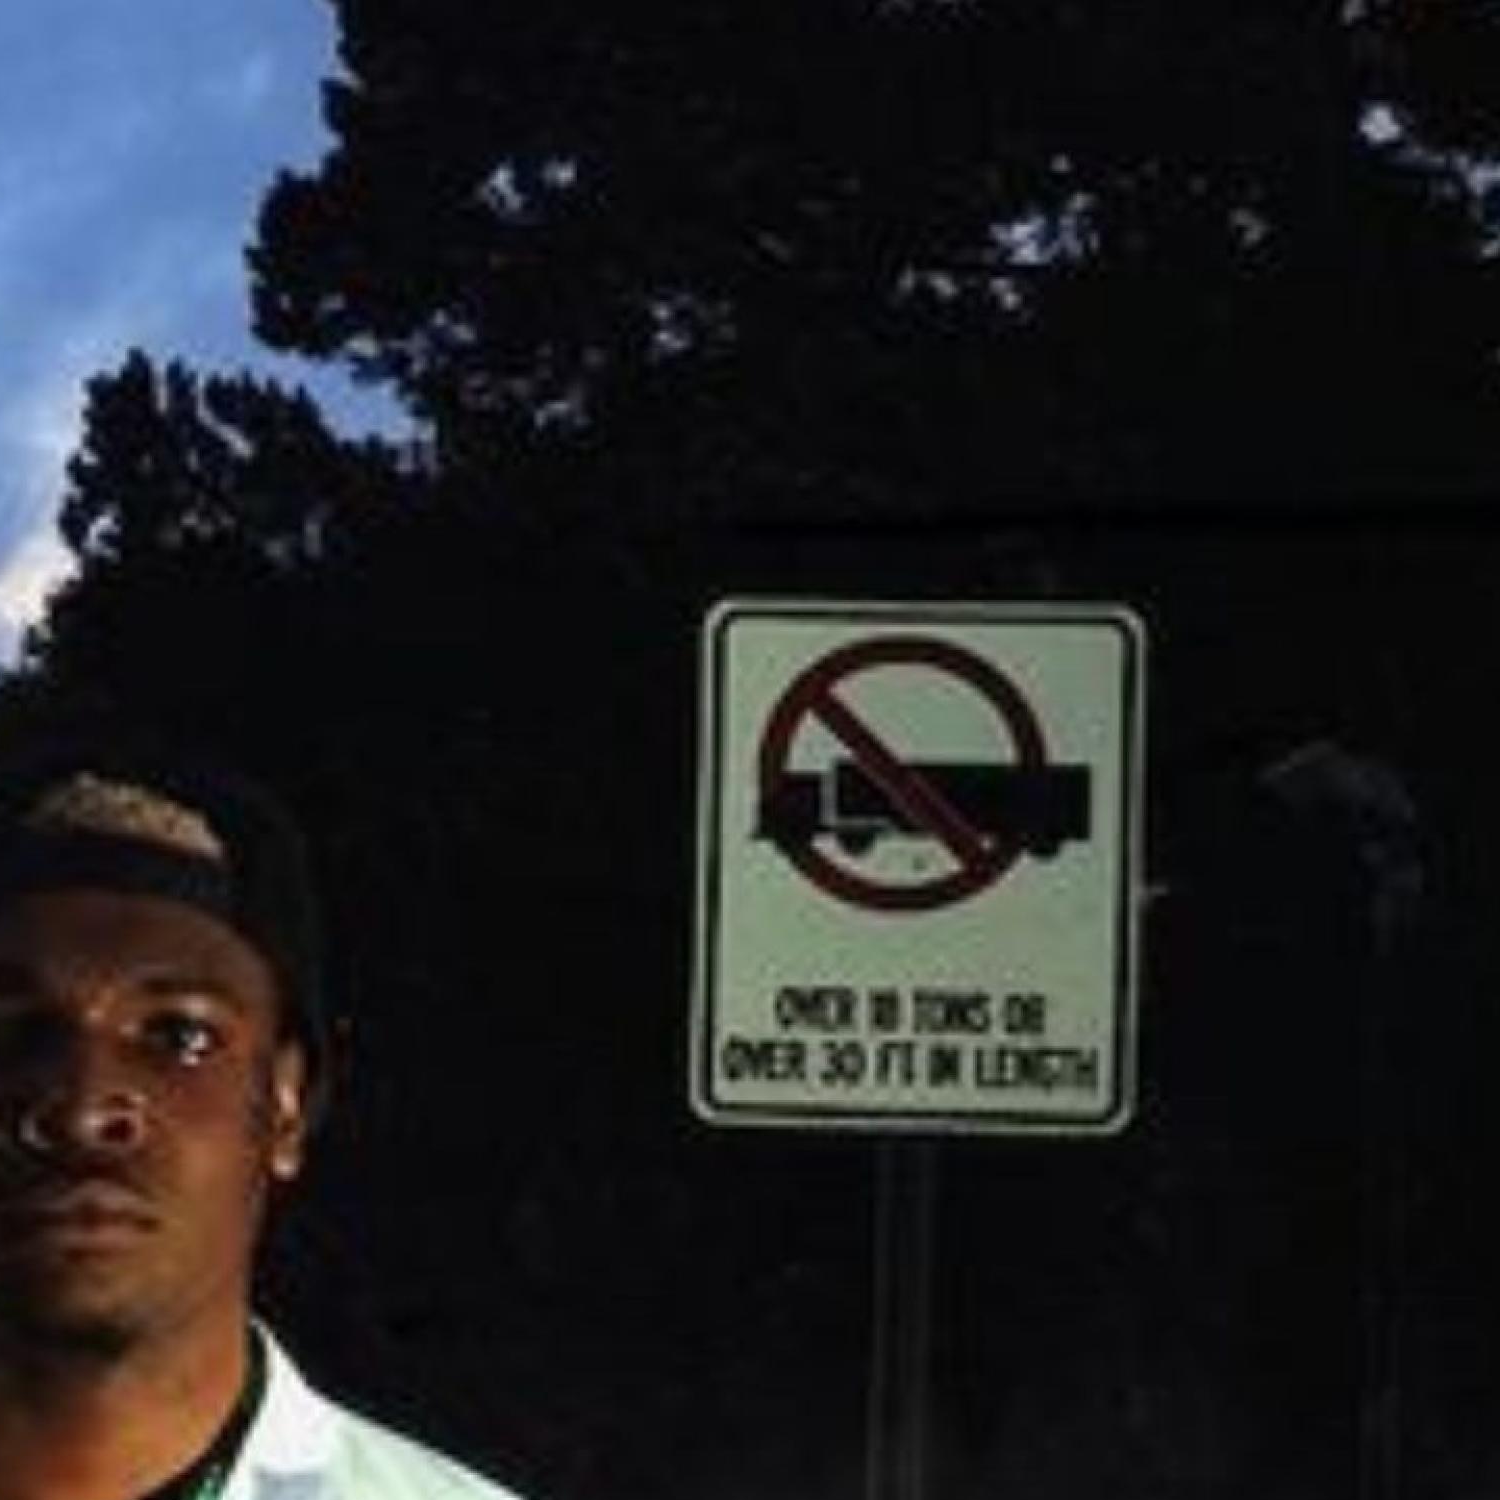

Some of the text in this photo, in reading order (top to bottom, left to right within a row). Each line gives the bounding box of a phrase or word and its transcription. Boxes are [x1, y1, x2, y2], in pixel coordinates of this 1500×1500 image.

[775, 984, 854, 1032] OVER
[912, 990, 992, 1034] TONS
[723, 1034, 807, 1082] OVER
[818, 1039, 867, 1086] 30
[973, 1046, 1099, 1093] LENGTH
